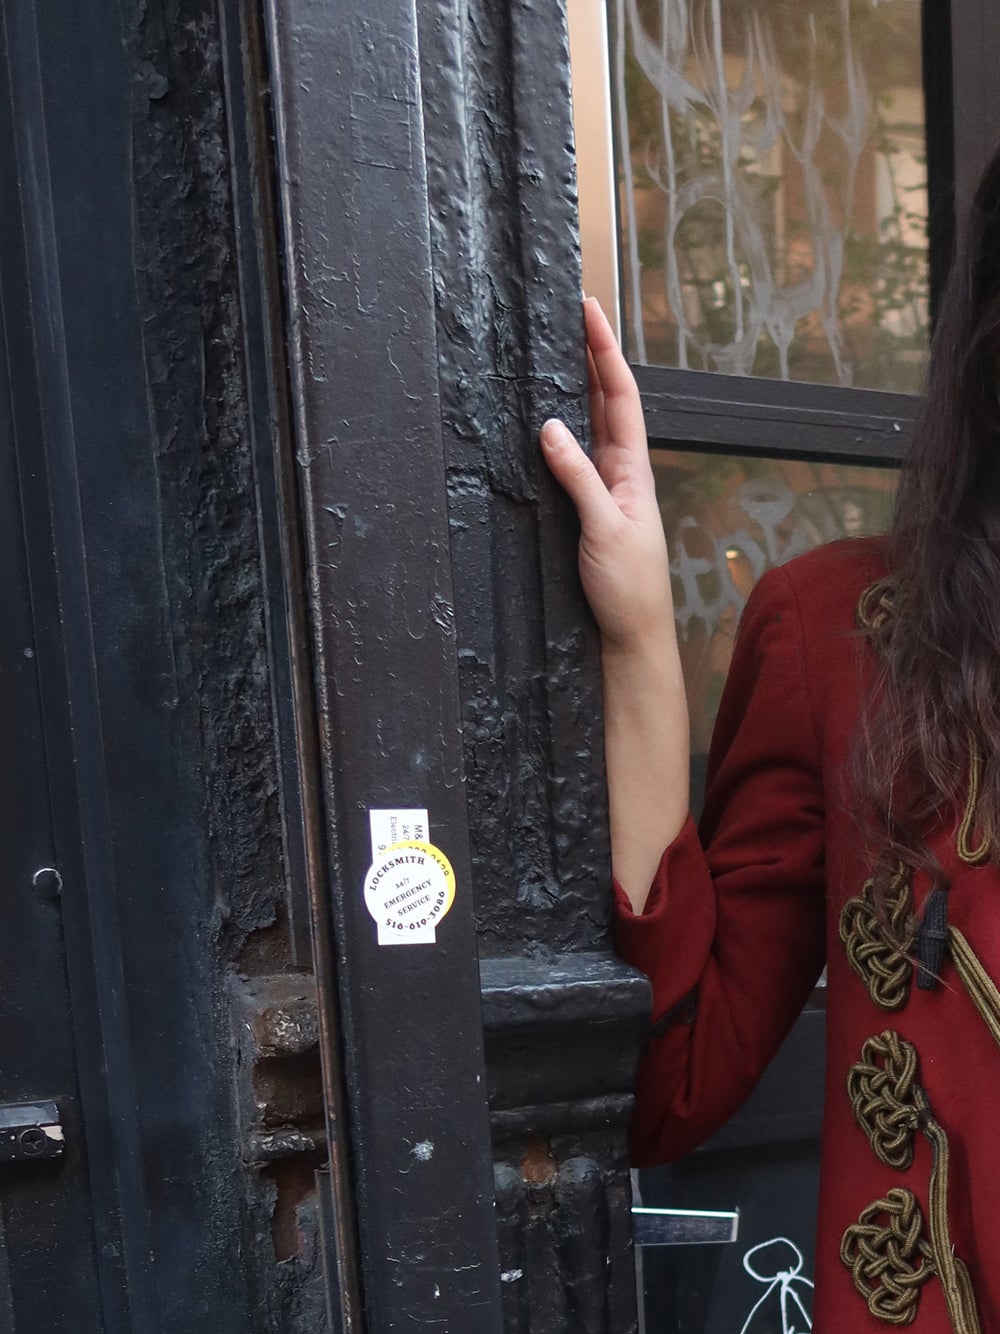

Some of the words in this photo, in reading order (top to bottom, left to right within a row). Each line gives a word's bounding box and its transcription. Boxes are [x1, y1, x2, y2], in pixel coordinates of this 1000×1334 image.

[369, 855, 425, 891] LOCKSMITH
[384, 879, 432, 909] EMERGENCY
[385, 891, 446, 930] 516-619-3086
[397, 894, 431, 916] SERVICE
